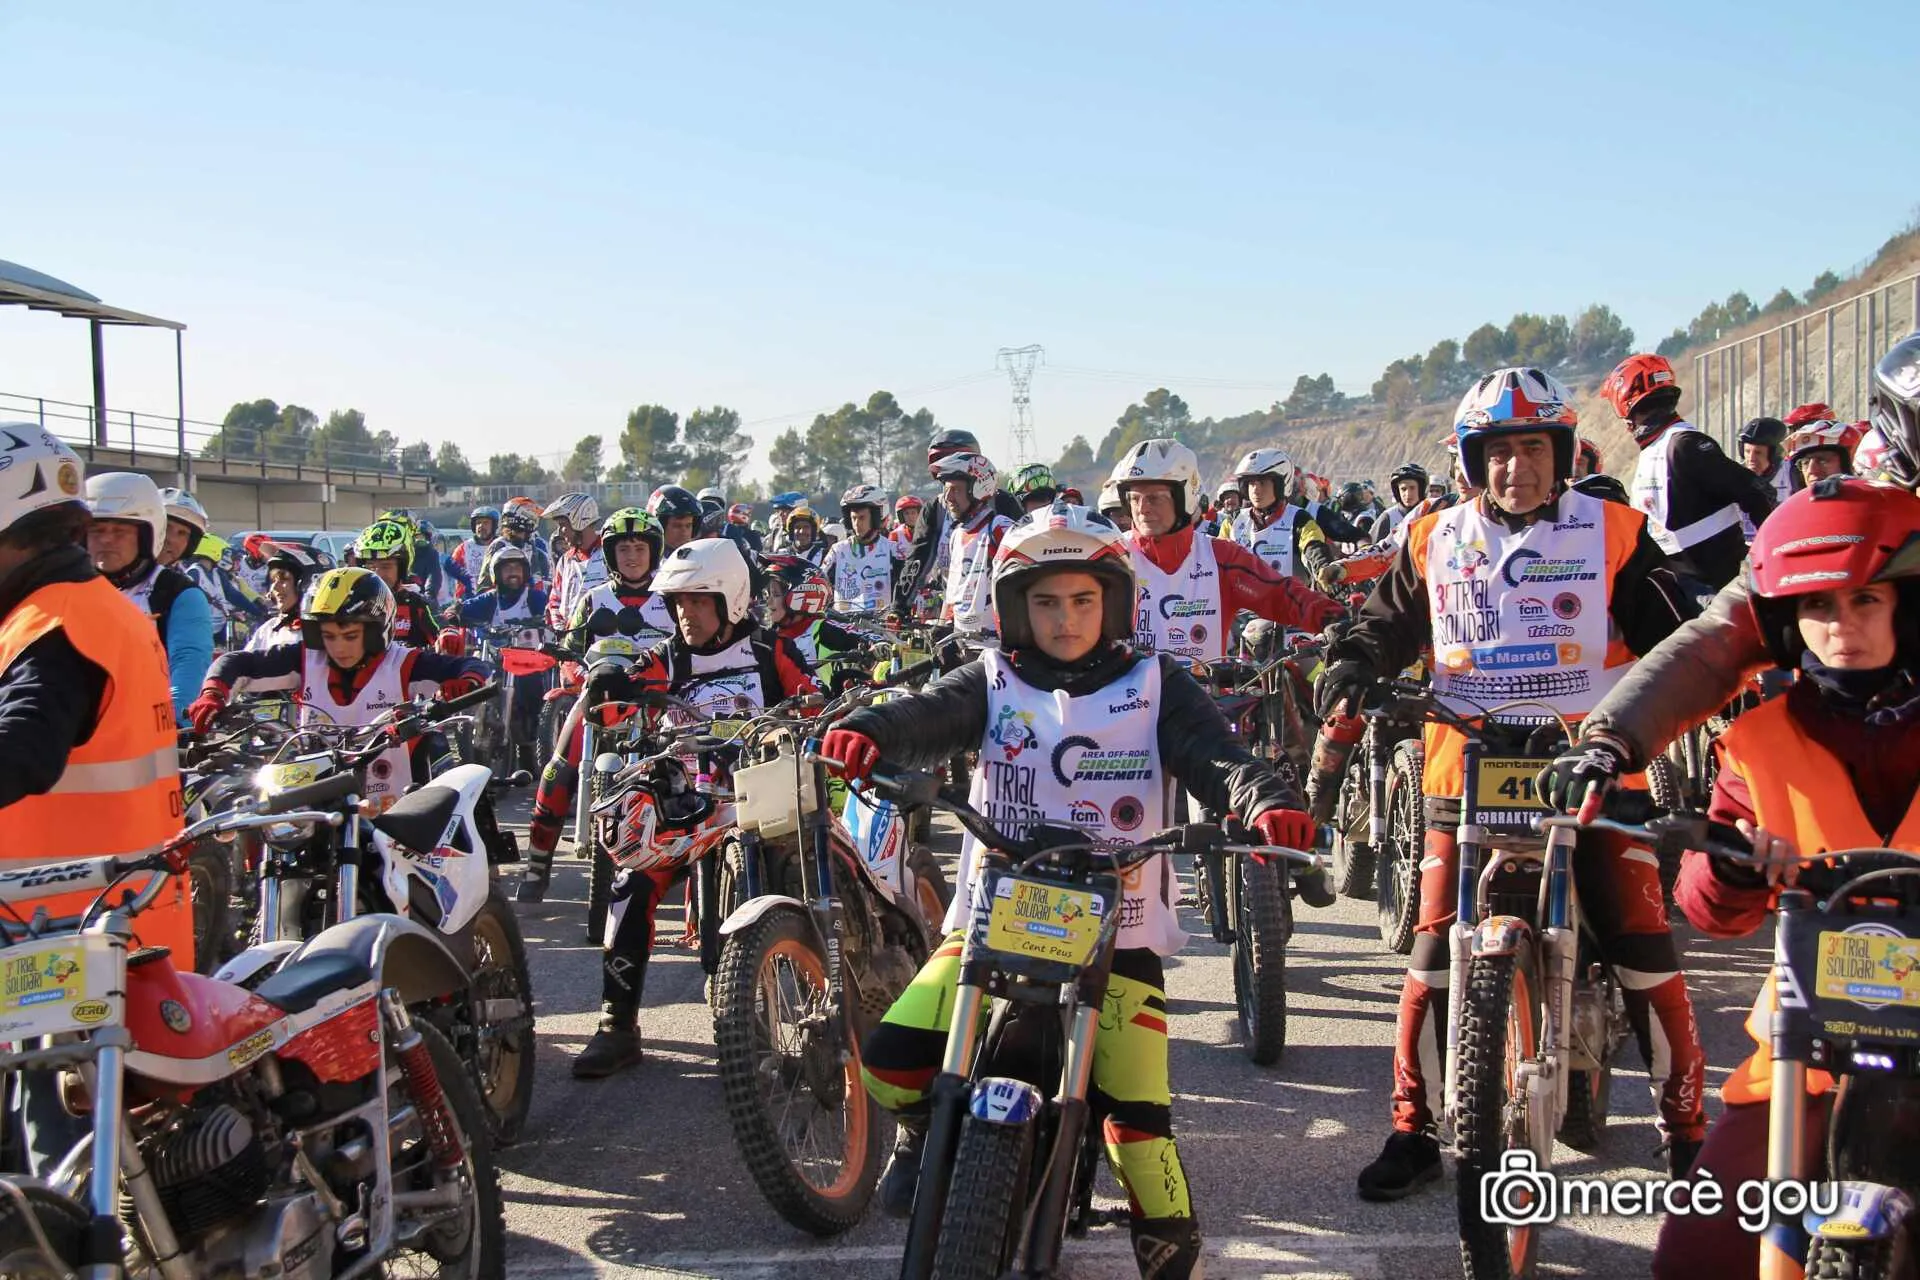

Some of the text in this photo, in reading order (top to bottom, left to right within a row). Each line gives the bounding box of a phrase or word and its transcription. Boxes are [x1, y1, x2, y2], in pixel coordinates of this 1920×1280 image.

[1043, 546, 1083, 555] hebo
[1523, 564, 1584, 574] CIRCUIT
[1519, 572, 1599, 583] PARCMOTOR
[1519, 604, 1543, 616] fcm
[1528, 624, 1575, 638] TrialGo
[1477, 653, 1493, 665] La
[1497, 649, 1551, 664] Marató
[1077, 758, 1149, 770] CIRCUIT
[1071, 806, 1100, 824] fcm
[22, 870, 93, 888] BAR
[1022, 941, 1073, 958] Cent Peus
[1858, 1025, 1881, 1035] Trial
[1897, 1029, 1919, 1039] Life
